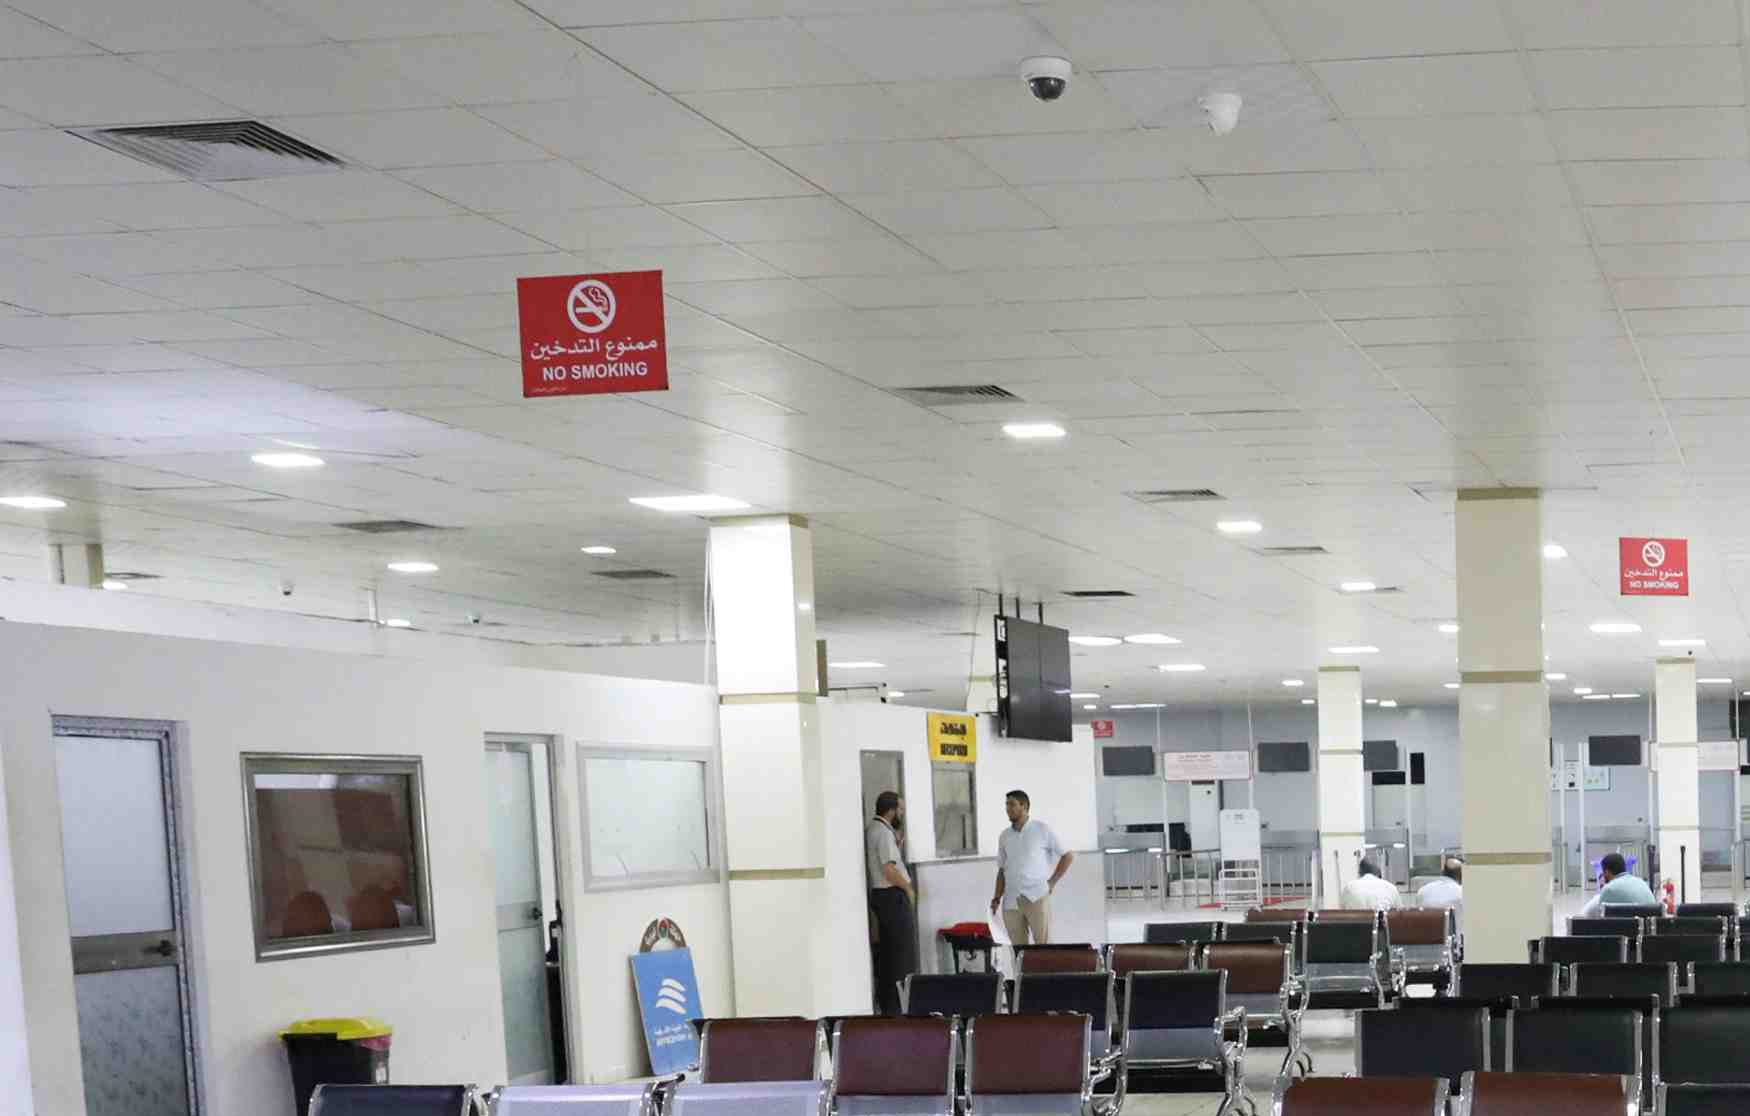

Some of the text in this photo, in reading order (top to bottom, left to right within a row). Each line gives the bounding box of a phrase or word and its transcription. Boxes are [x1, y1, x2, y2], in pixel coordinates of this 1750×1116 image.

[530, 336, 658, 360] ممنوع التدخين
[543, 362, 648, 381] NO SMOKING
[1624, 568, 1683, 581] ممنوع التدخين
[1629, 580, 1679, 589] NO SMOKING
